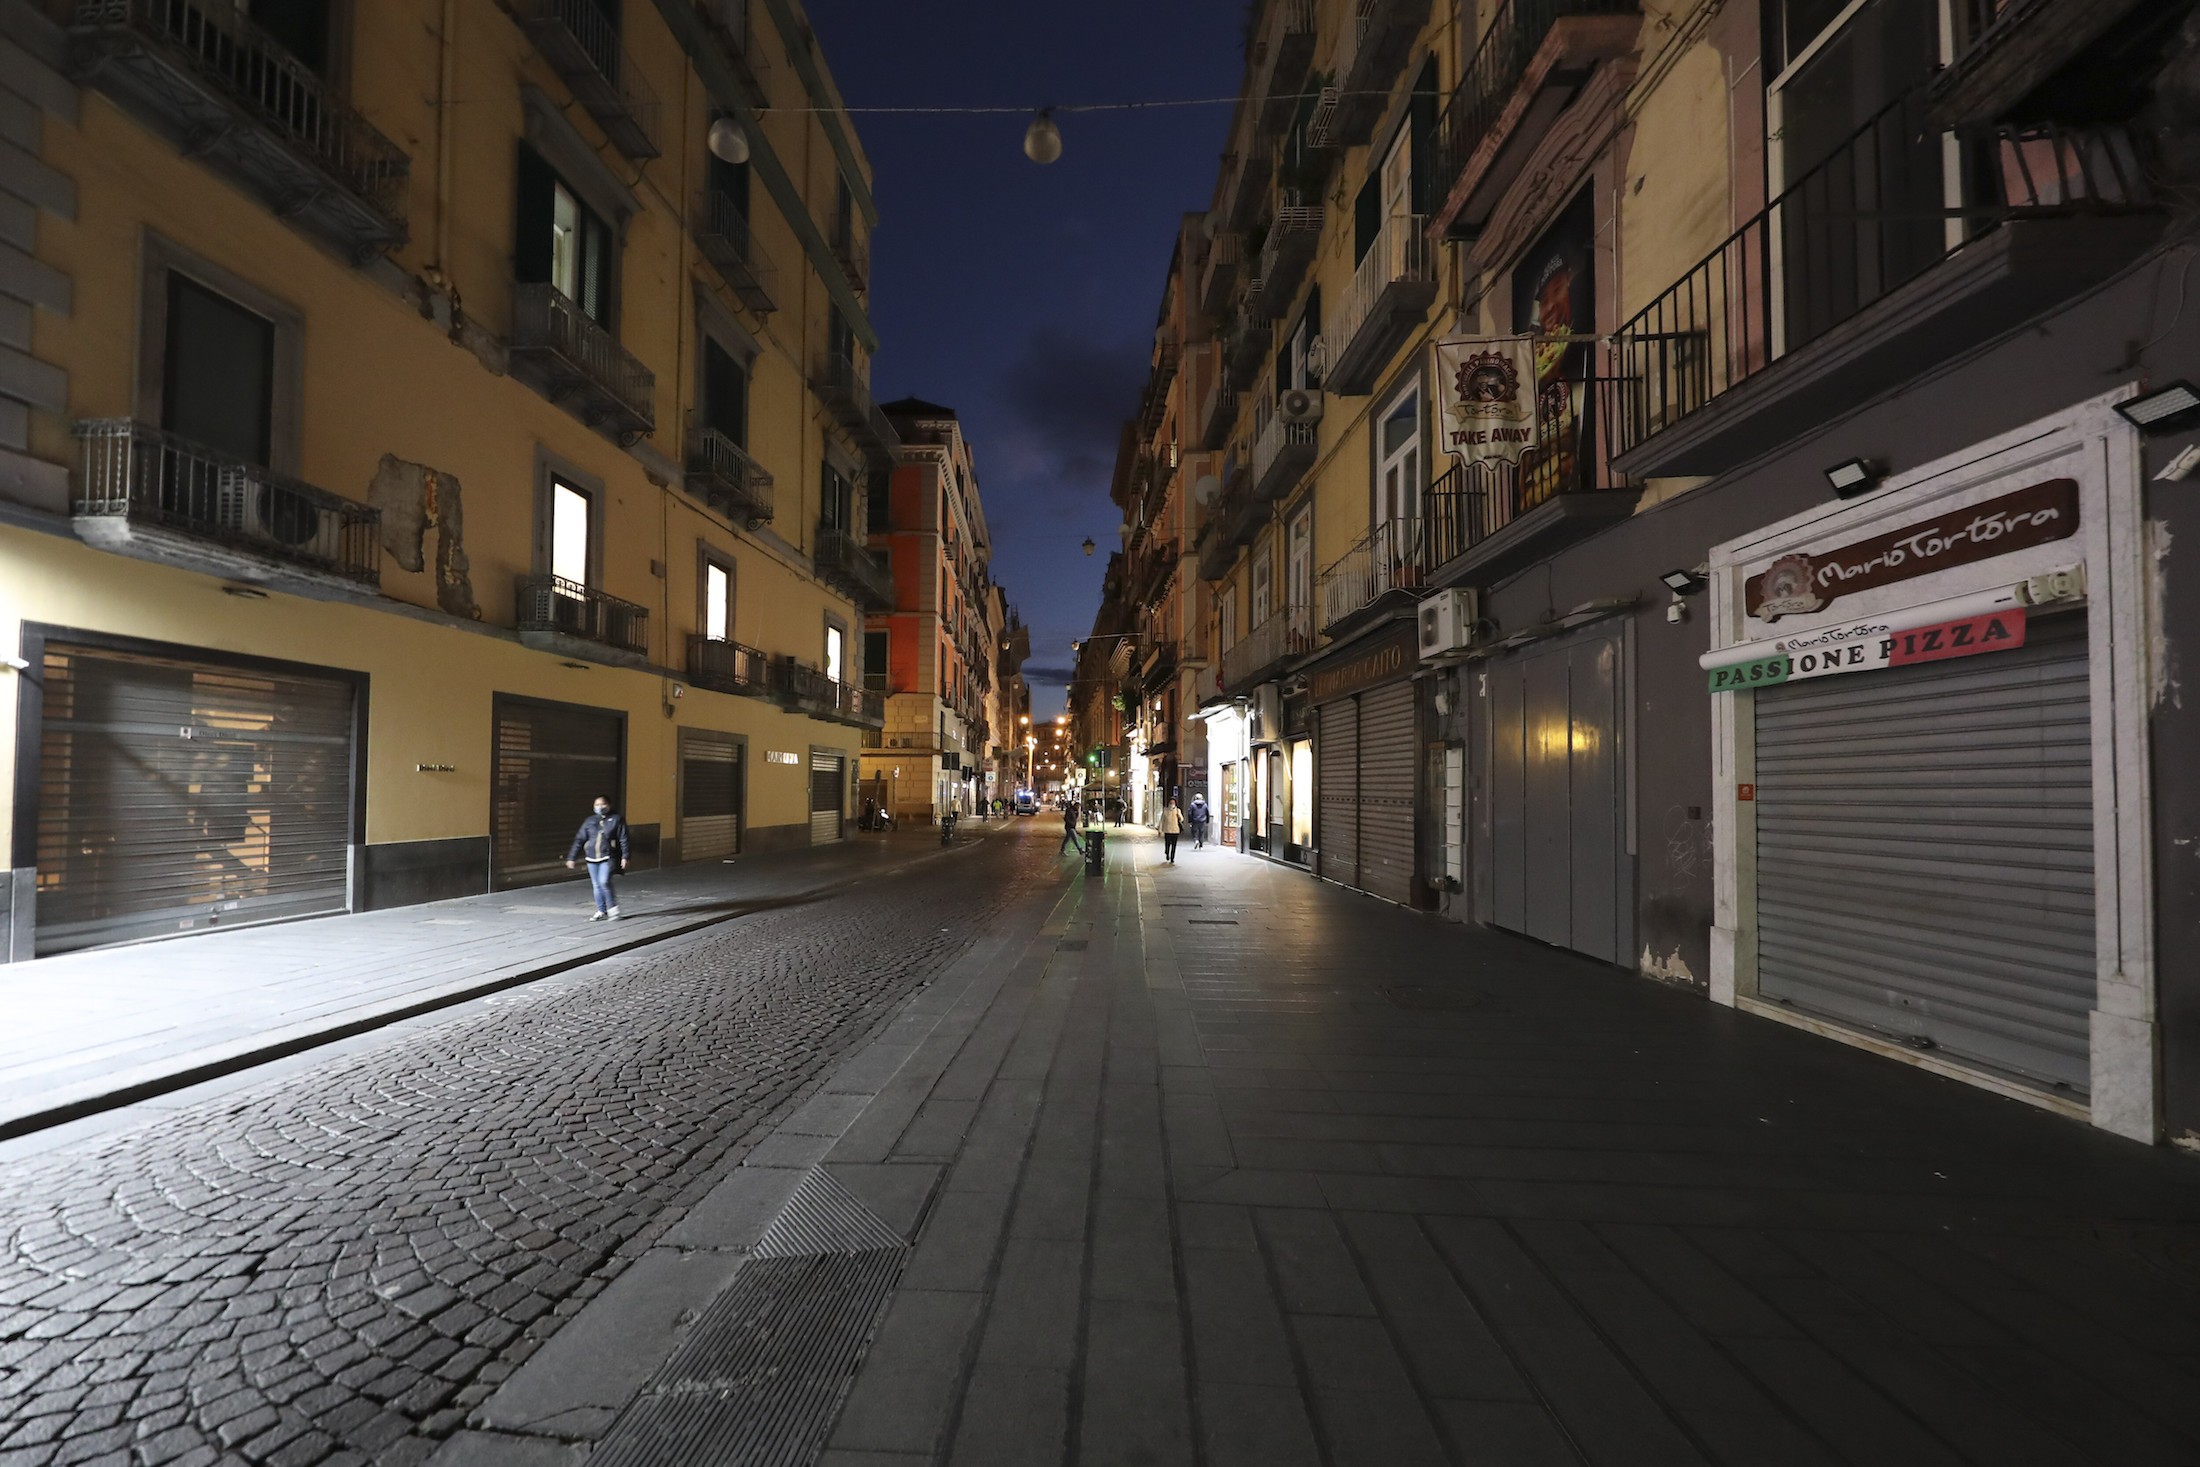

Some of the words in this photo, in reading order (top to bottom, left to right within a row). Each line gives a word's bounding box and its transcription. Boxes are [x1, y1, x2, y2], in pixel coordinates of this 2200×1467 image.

[1450, 430, 1487, 446] TAKE
[1491, 427, 1532, 443] AWAY
[1715, 644, 1866, 688] PASSIONE
[1880, 617, 2012, 660] PIZZA
